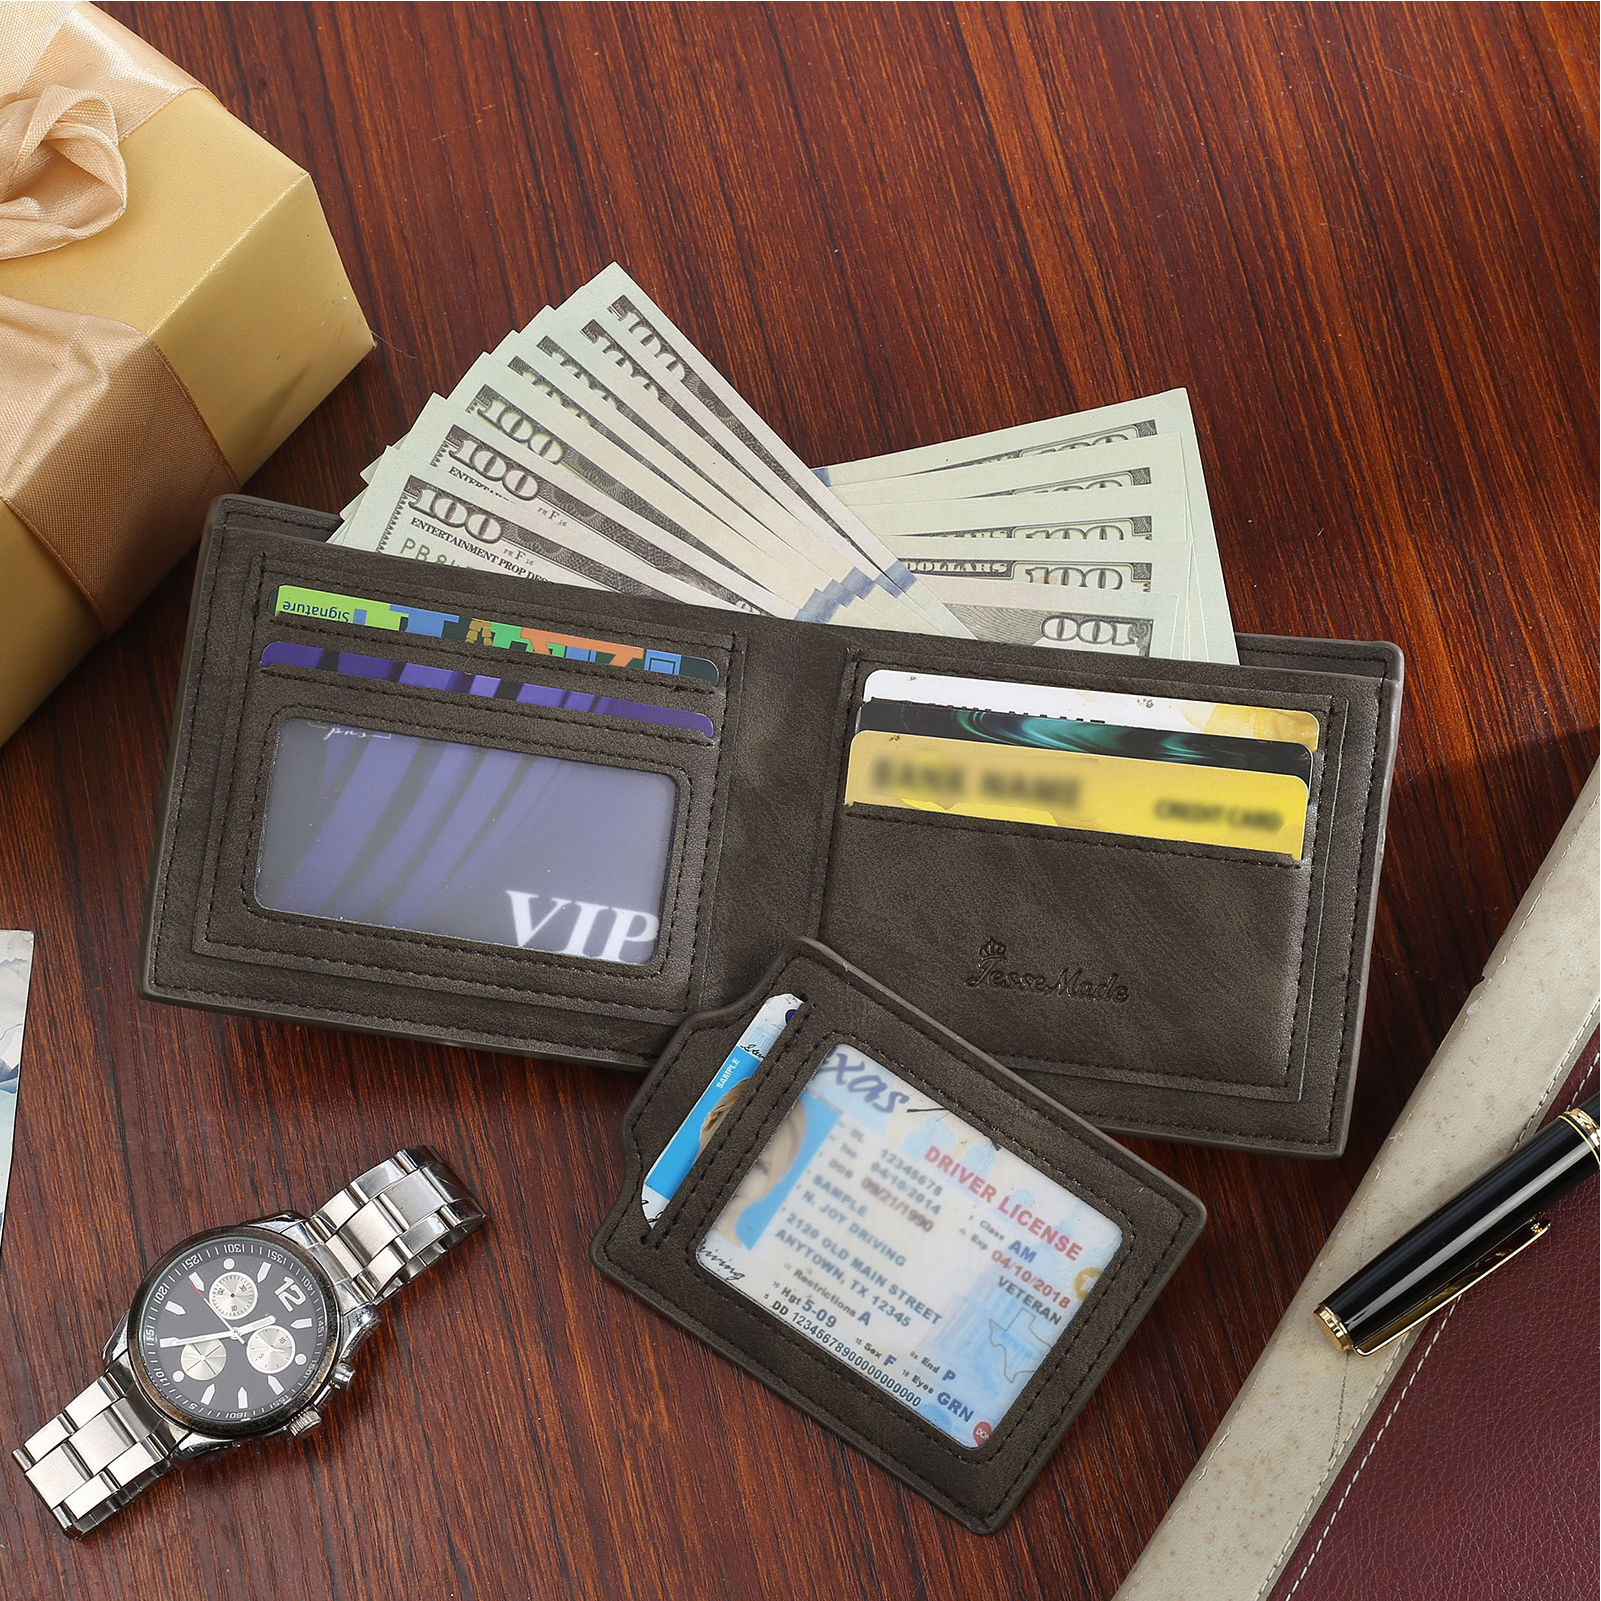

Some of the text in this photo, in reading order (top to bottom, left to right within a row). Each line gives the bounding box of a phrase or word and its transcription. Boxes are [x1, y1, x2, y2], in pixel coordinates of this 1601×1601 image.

[477, 399, 564, 465] 100
[448, 439, 539, 501] 100
[408, 489, 503, 544] 100
[410, 517, 498, 565] ENTERTAINMENT
[499, 557, 527, 579] PROP
[282, 601, 350, 623] Signature
[505, 890, 660, 962] VIP
[716, 1058, 740, 1089] SAMPLE
[813, 1175, 868, 1217] SAMPLE
[881, 1149, 943, 1196] 12345678
[924, 1145, 1083, 1261] DRIVER LICENSE
[819, 1203, 847, 1225] JOY
[849, 1222, 907, 1267] DRIVING
[1008, 1240, 1037, 1263] AM
[275, 1276, 306, 1312] 12
[775, 1229, 912, 1327] ANYTOWN, TX 12345
[786, 1212, 943, 1325] 2120 OLD MAIN STREET
[991, 1249, 1071, 1310] 04/10/2018
[771, 1300, 789, 1316] DD
[781, 1286, 802, 1306] Hgt
[801, 1298, 838, 1328] 5-09
[793, 1268, 856, 1317] Restrictions
[857, 1311, 872, 1326] A
[997, 1275, 1062, 1326] VETERAN
[864, 1343, 883, 1360] Sex
[883, 1354, 897, 1367] F
[921, 1356, 941, 1374] End
[941, 1369, 957, 1382] P
[911, 1374, 935, 1394] Eyes
[937, 1391, 975, 1423] GRN
